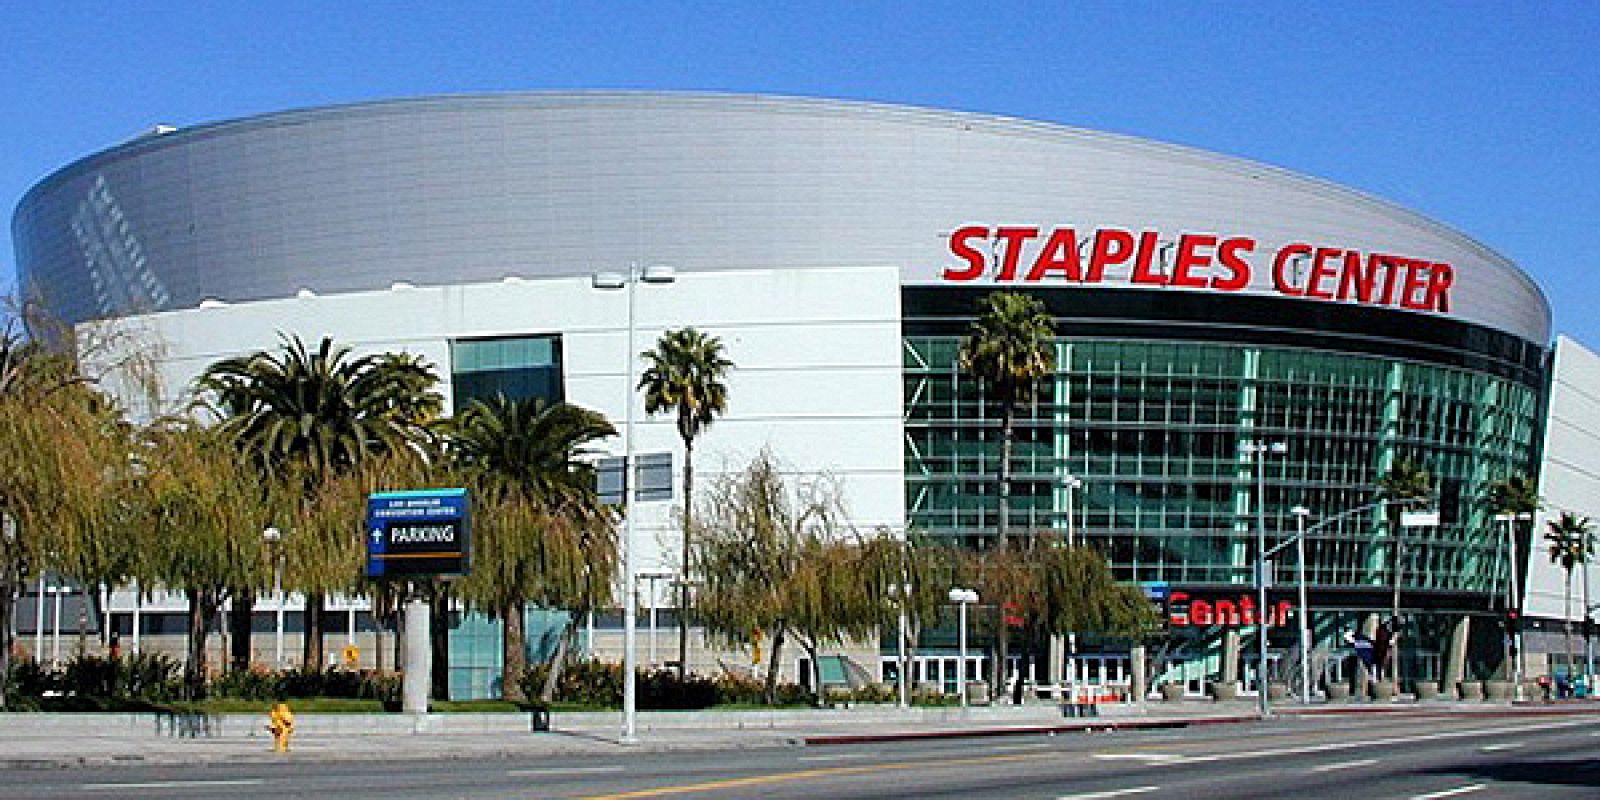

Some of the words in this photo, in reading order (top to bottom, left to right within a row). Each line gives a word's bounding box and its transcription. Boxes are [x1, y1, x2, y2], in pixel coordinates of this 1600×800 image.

[943, 226, 1256, 290] STAPLES
[1271, 243, 1455, 312] CENTER
[391, 525, 454, 544] PARKING
